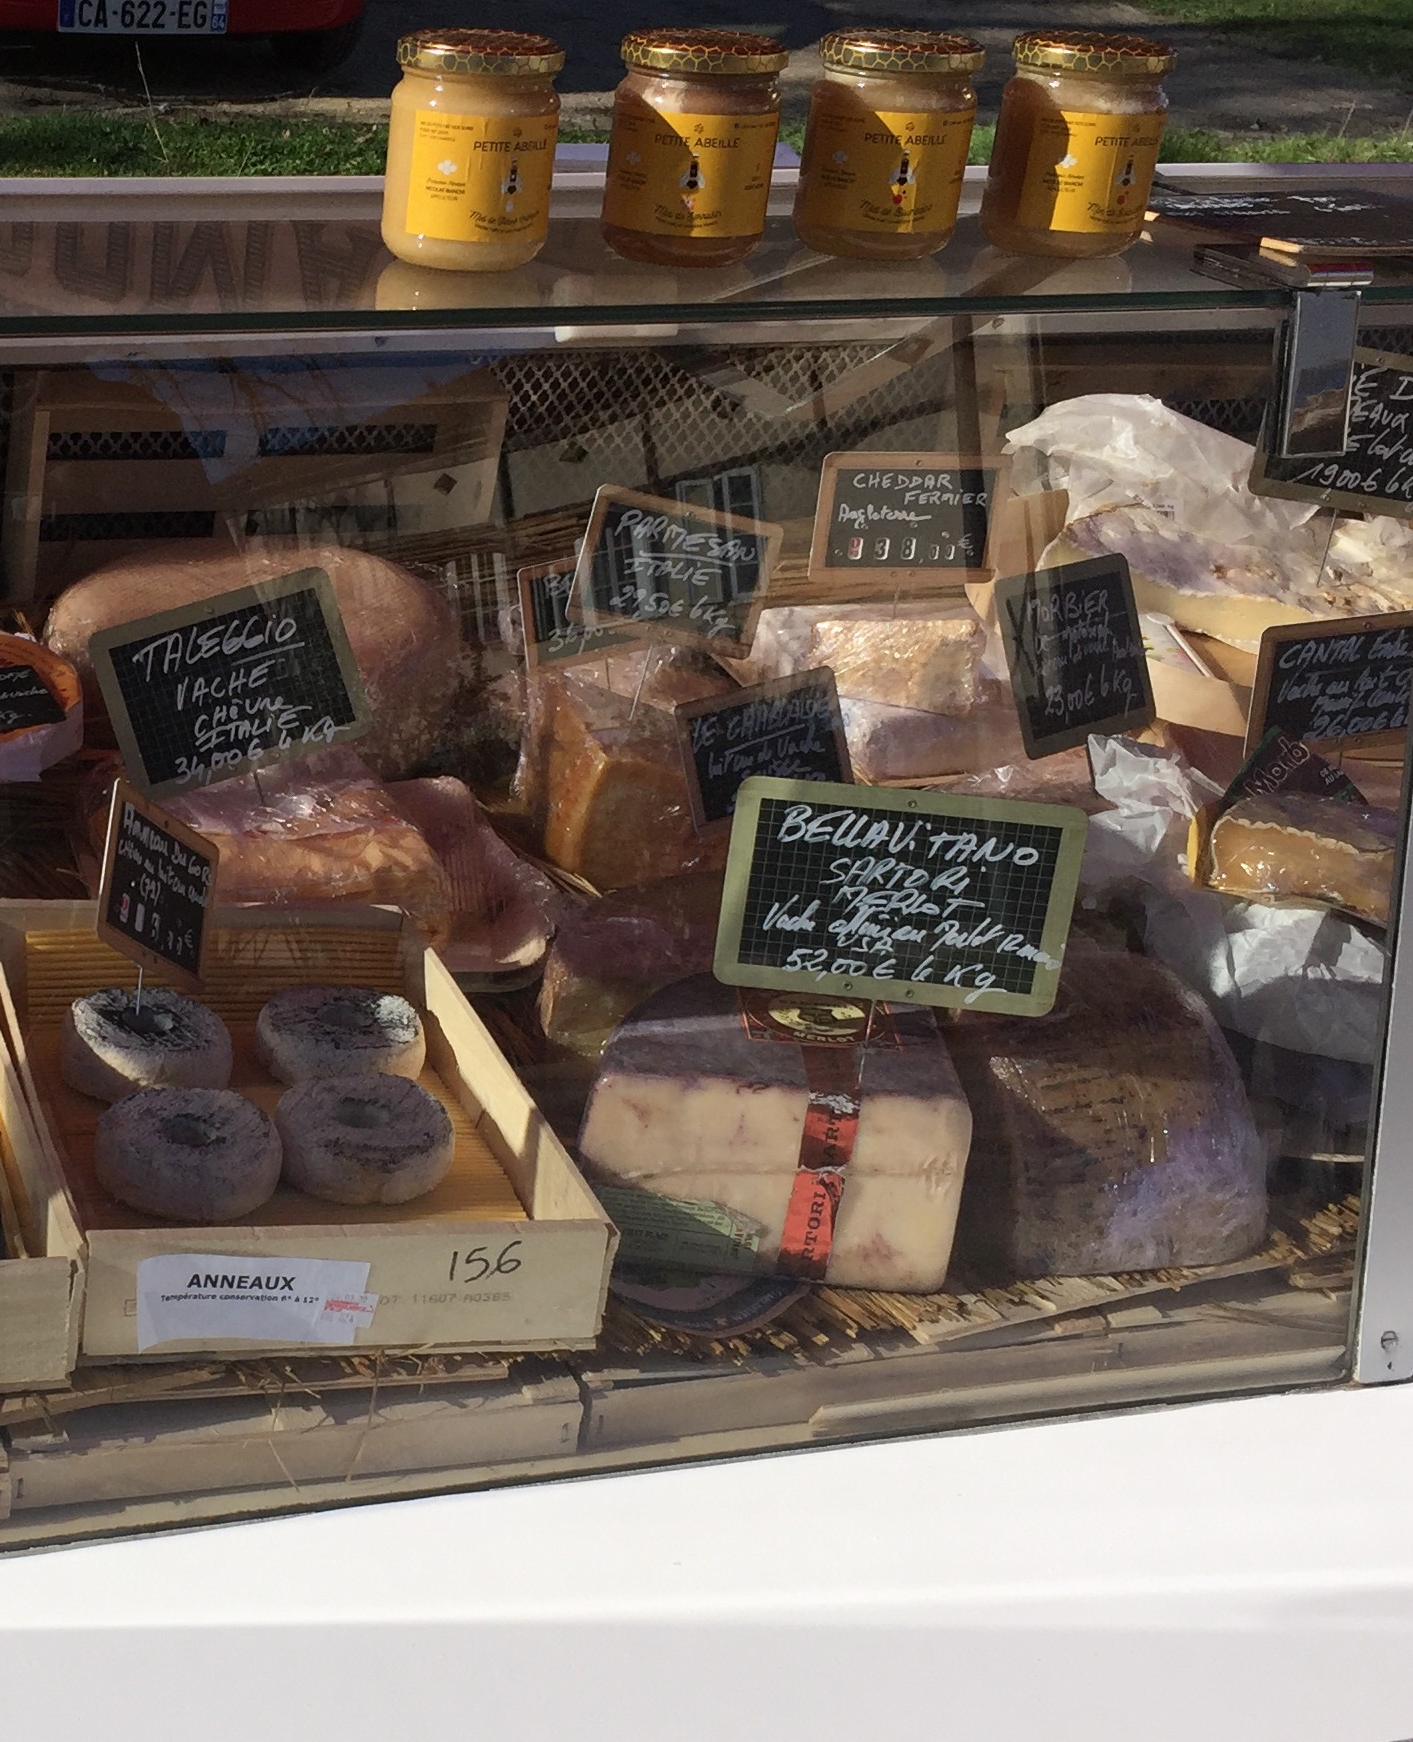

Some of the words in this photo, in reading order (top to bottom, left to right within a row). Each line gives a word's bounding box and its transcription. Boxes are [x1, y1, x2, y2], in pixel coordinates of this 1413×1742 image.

[473, 139, 510, 152] PETITE
[654, 133, 690, 148] PETITE
[693, 136, 740, 149] ABEILLE
[864, 133, 902, 146] PETITE
[904, 133, 947, 146] ABEILLE
[1094, 135, 1130, 148] PETITE
[852, 472, 954, 490] CHEDDAR
[903, 488, 988, 507] FERMIER
[614, 509, 756, 562] PARMESAN
[624, 556, 722, 587] ITALIE
[1026, 588, 1109, 623] MORBIER
[132, 614, 298, 682] TALEGGIO
[1279, 636, 1365, 670] CANTAL
[177, 659, 277, 711] VACHE
[195, 704, 312, 753] ITALIE
[793, 1030, 856, 1044] MERLOT
[803, 1189, 828, 1262] RTORI
[449, 1240, 523, 1283] 156
[187, 1273, 297, 1291] ANNEAUX
[159, 1293, 217, 1305] Température
[218, 1293, 279, 1303] conservation
